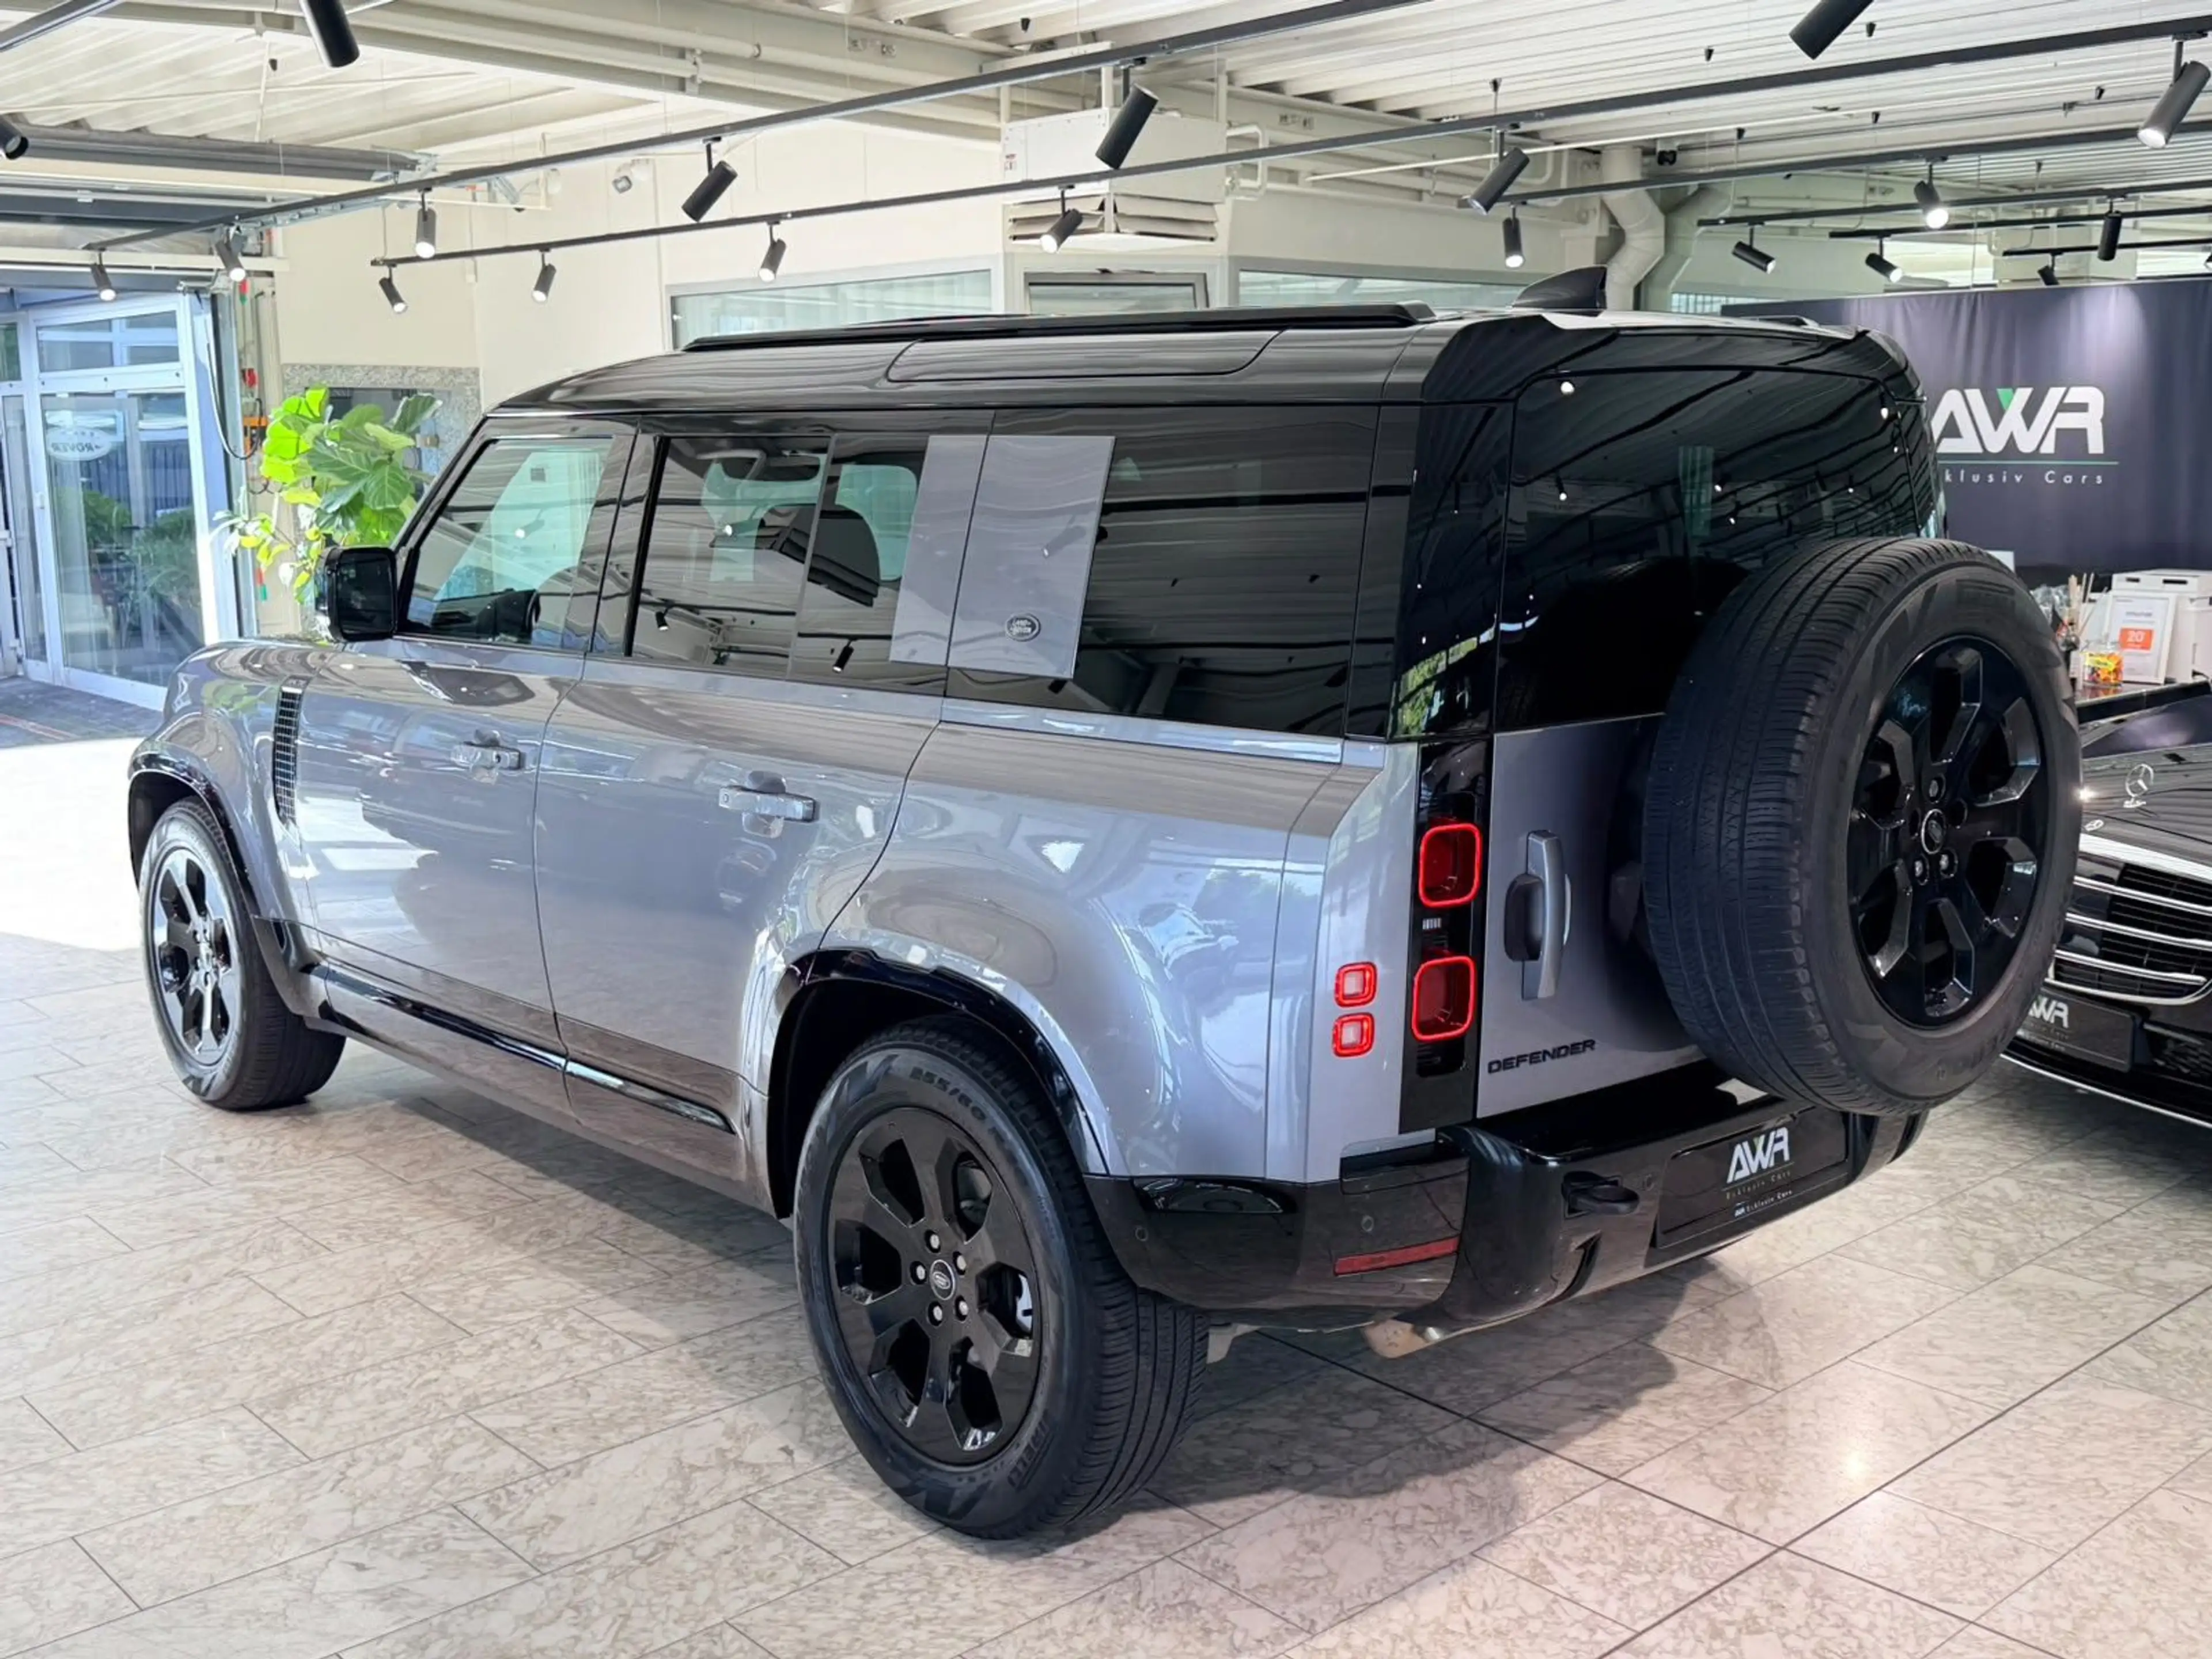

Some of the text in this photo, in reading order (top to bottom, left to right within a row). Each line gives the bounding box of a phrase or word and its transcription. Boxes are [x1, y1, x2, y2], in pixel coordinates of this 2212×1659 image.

[1931, 386, 2105, 454] AWR
[1945, 469, 2103, 484] klusiv Cars
[1487, 1039, 1596, 1074] DEFENDER
[1726, 1126, 1790, 1184] AWR
